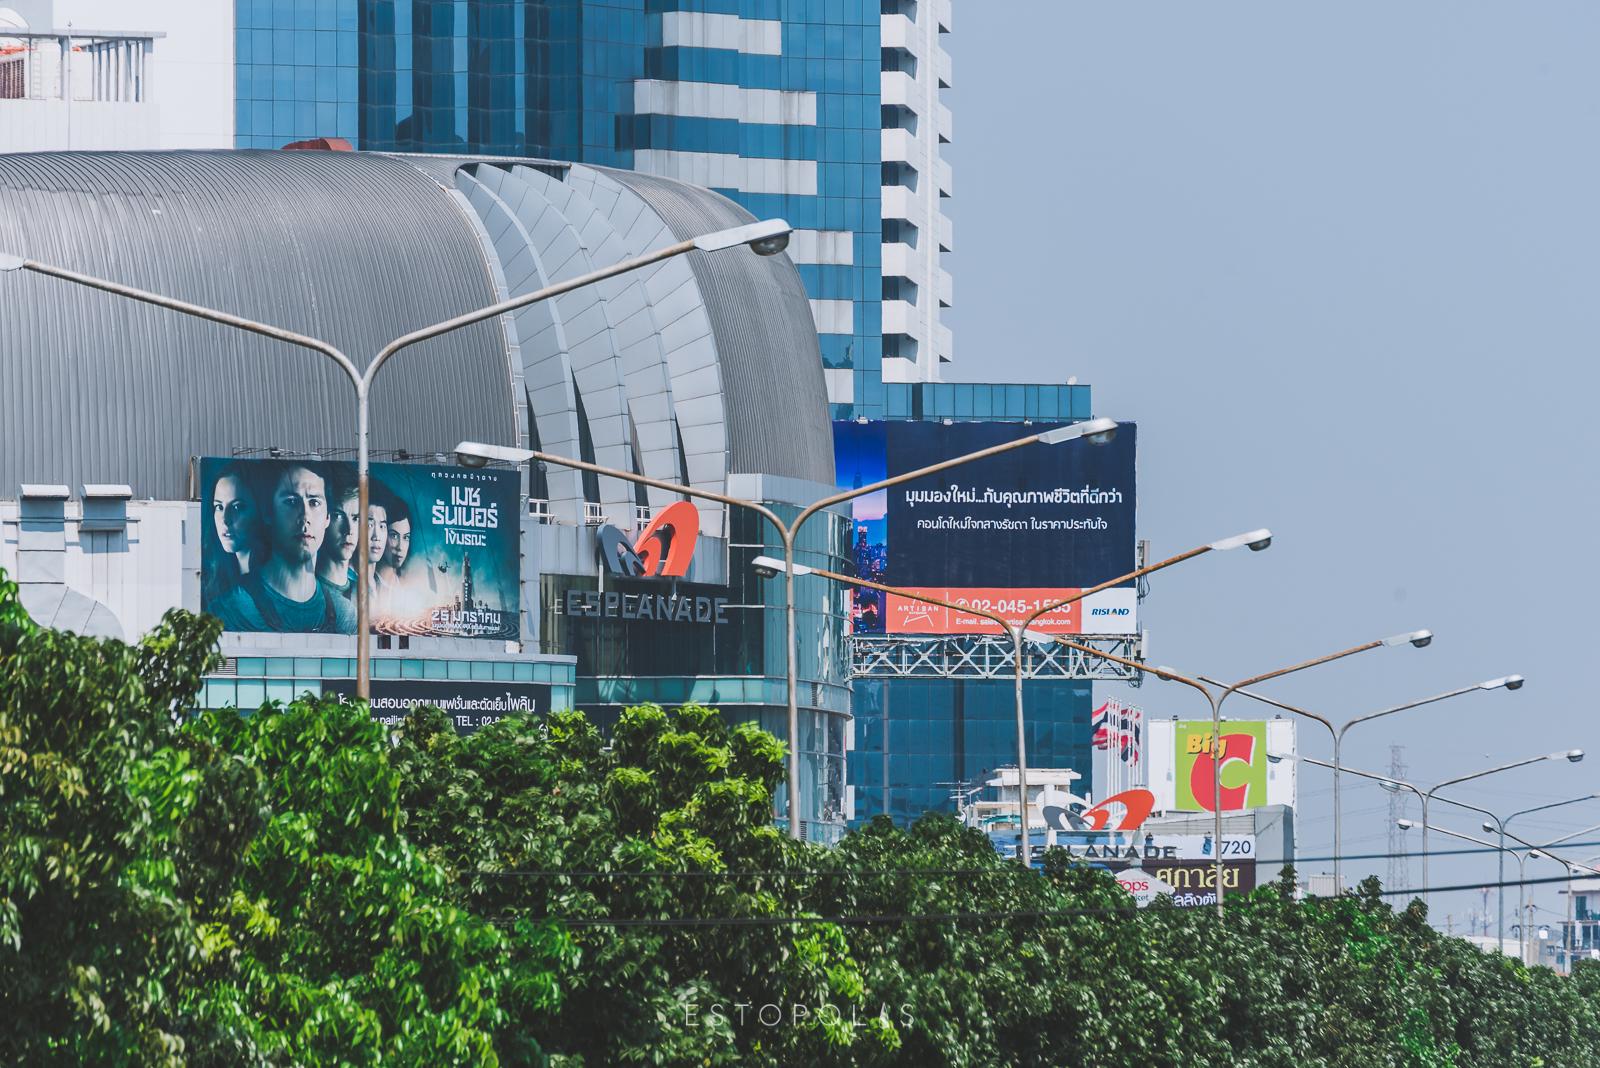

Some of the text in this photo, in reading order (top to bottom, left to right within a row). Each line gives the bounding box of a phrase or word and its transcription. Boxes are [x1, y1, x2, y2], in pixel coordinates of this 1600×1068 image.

[566, 588, 729, 624] ESPLANADE
[897, 605, 939, 613] ARTISAN
[1091, 608, 1130, 616] RISLAND
[456, 715, 474, 727] TEL
[1187, 733, 1227, 761] Big
[1190, 734, 1256, 813] C
